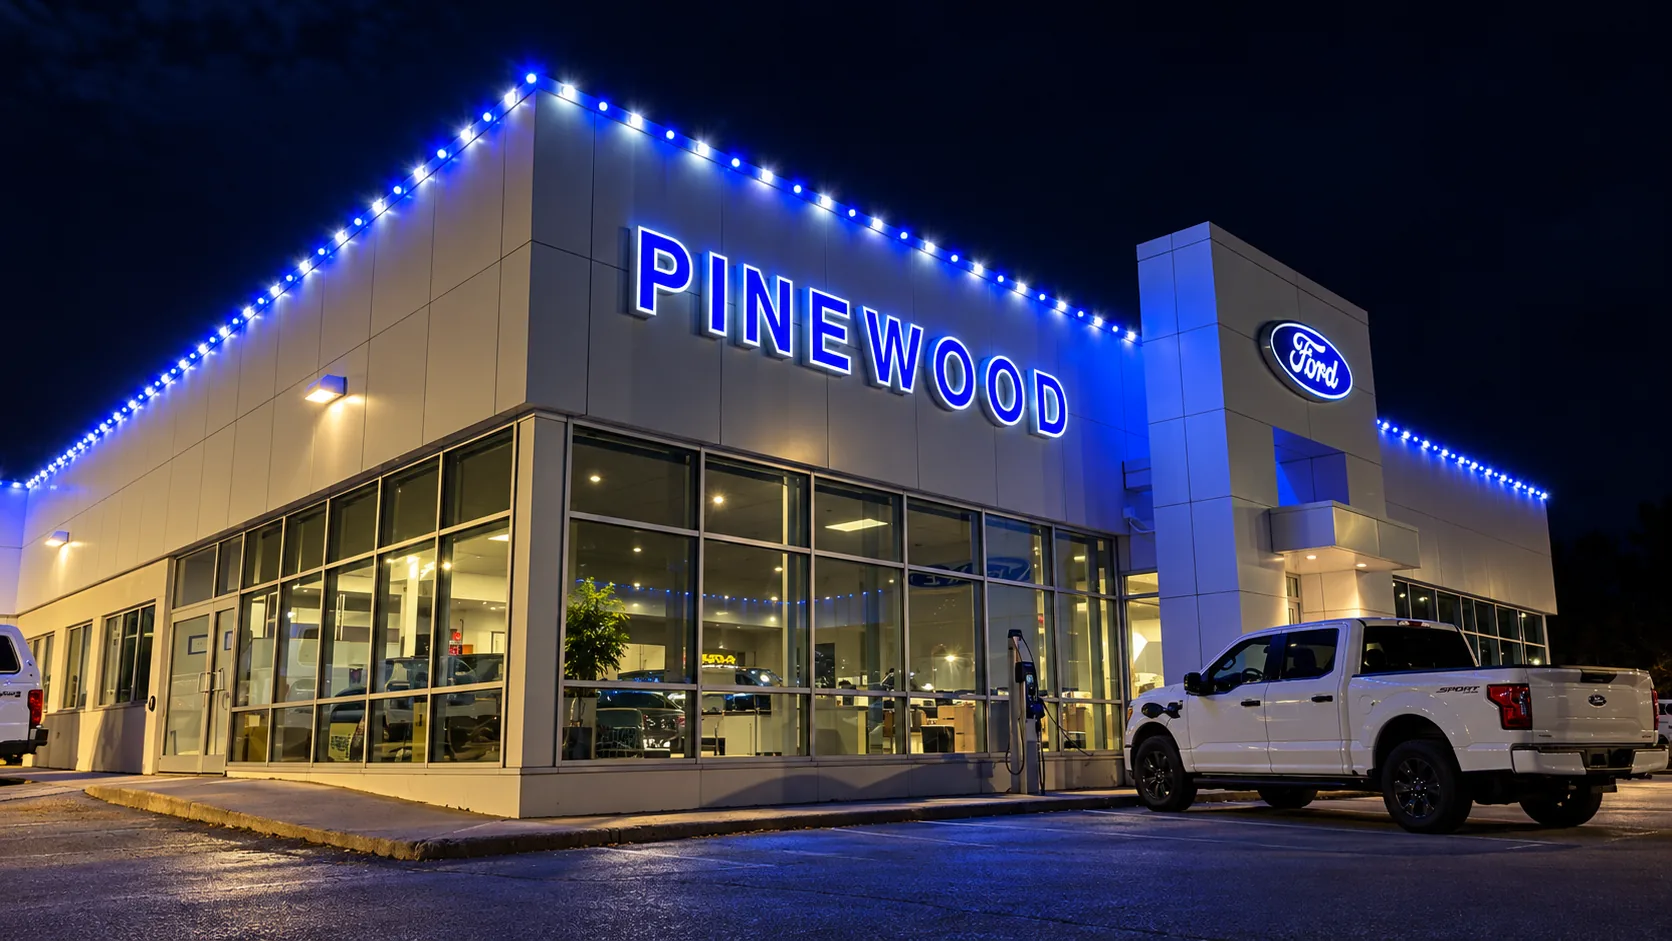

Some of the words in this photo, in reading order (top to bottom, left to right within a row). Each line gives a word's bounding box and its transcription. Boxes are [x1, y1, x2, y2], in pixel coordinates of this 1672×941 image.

[635, 225, 1069, 438] PINEWOOD
[1289, 332, 1339, 389] Ford
[1436, 685, 1480, 693] SPORT
